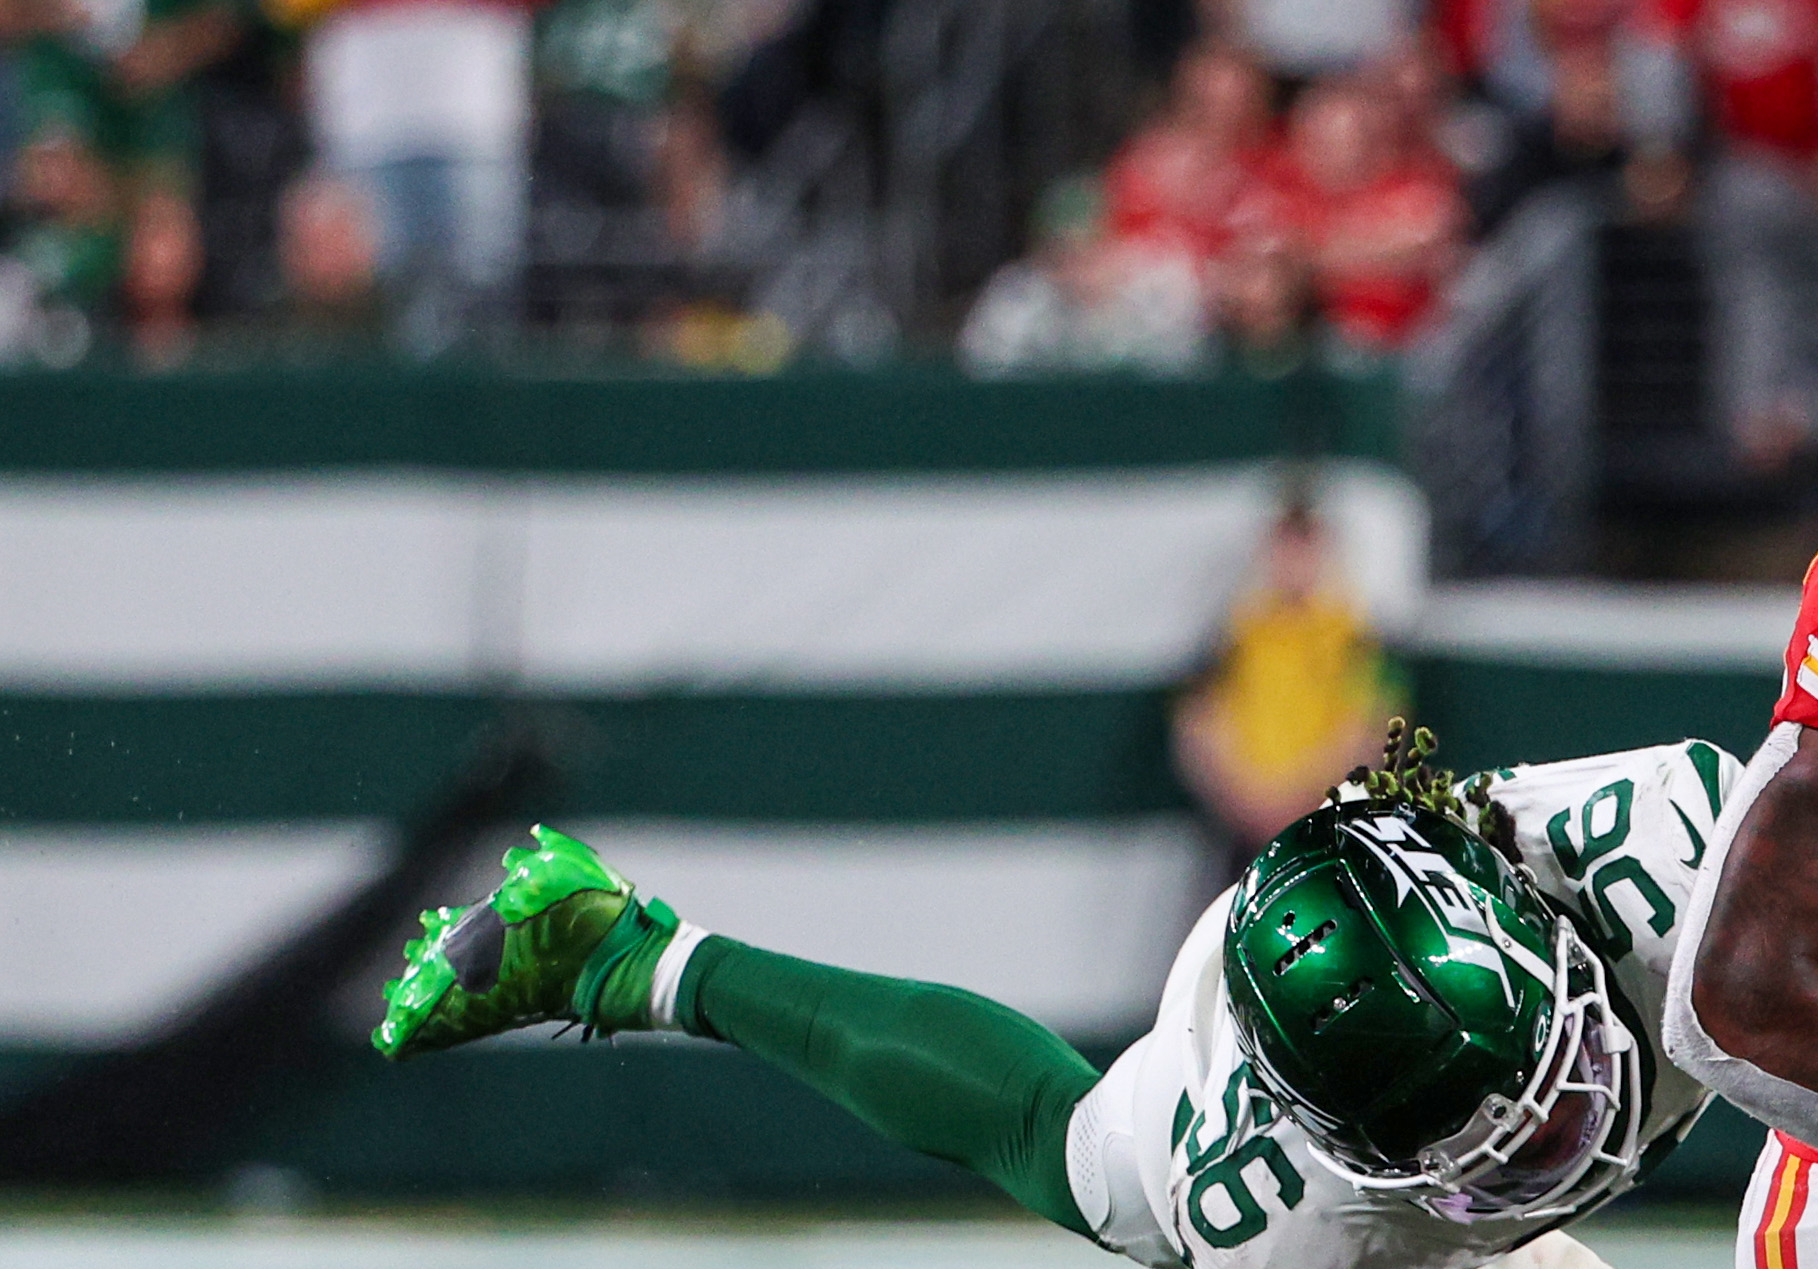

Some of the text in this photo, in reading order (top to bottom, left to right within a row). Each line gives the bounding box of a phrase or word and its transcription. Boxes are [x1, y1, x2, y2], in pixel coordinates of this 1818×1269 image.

[1336, 816, 1516, 1009] JETS
[1546, 778, 1675, 960] 56
[1186, 1061, 1305, 1249] 56
